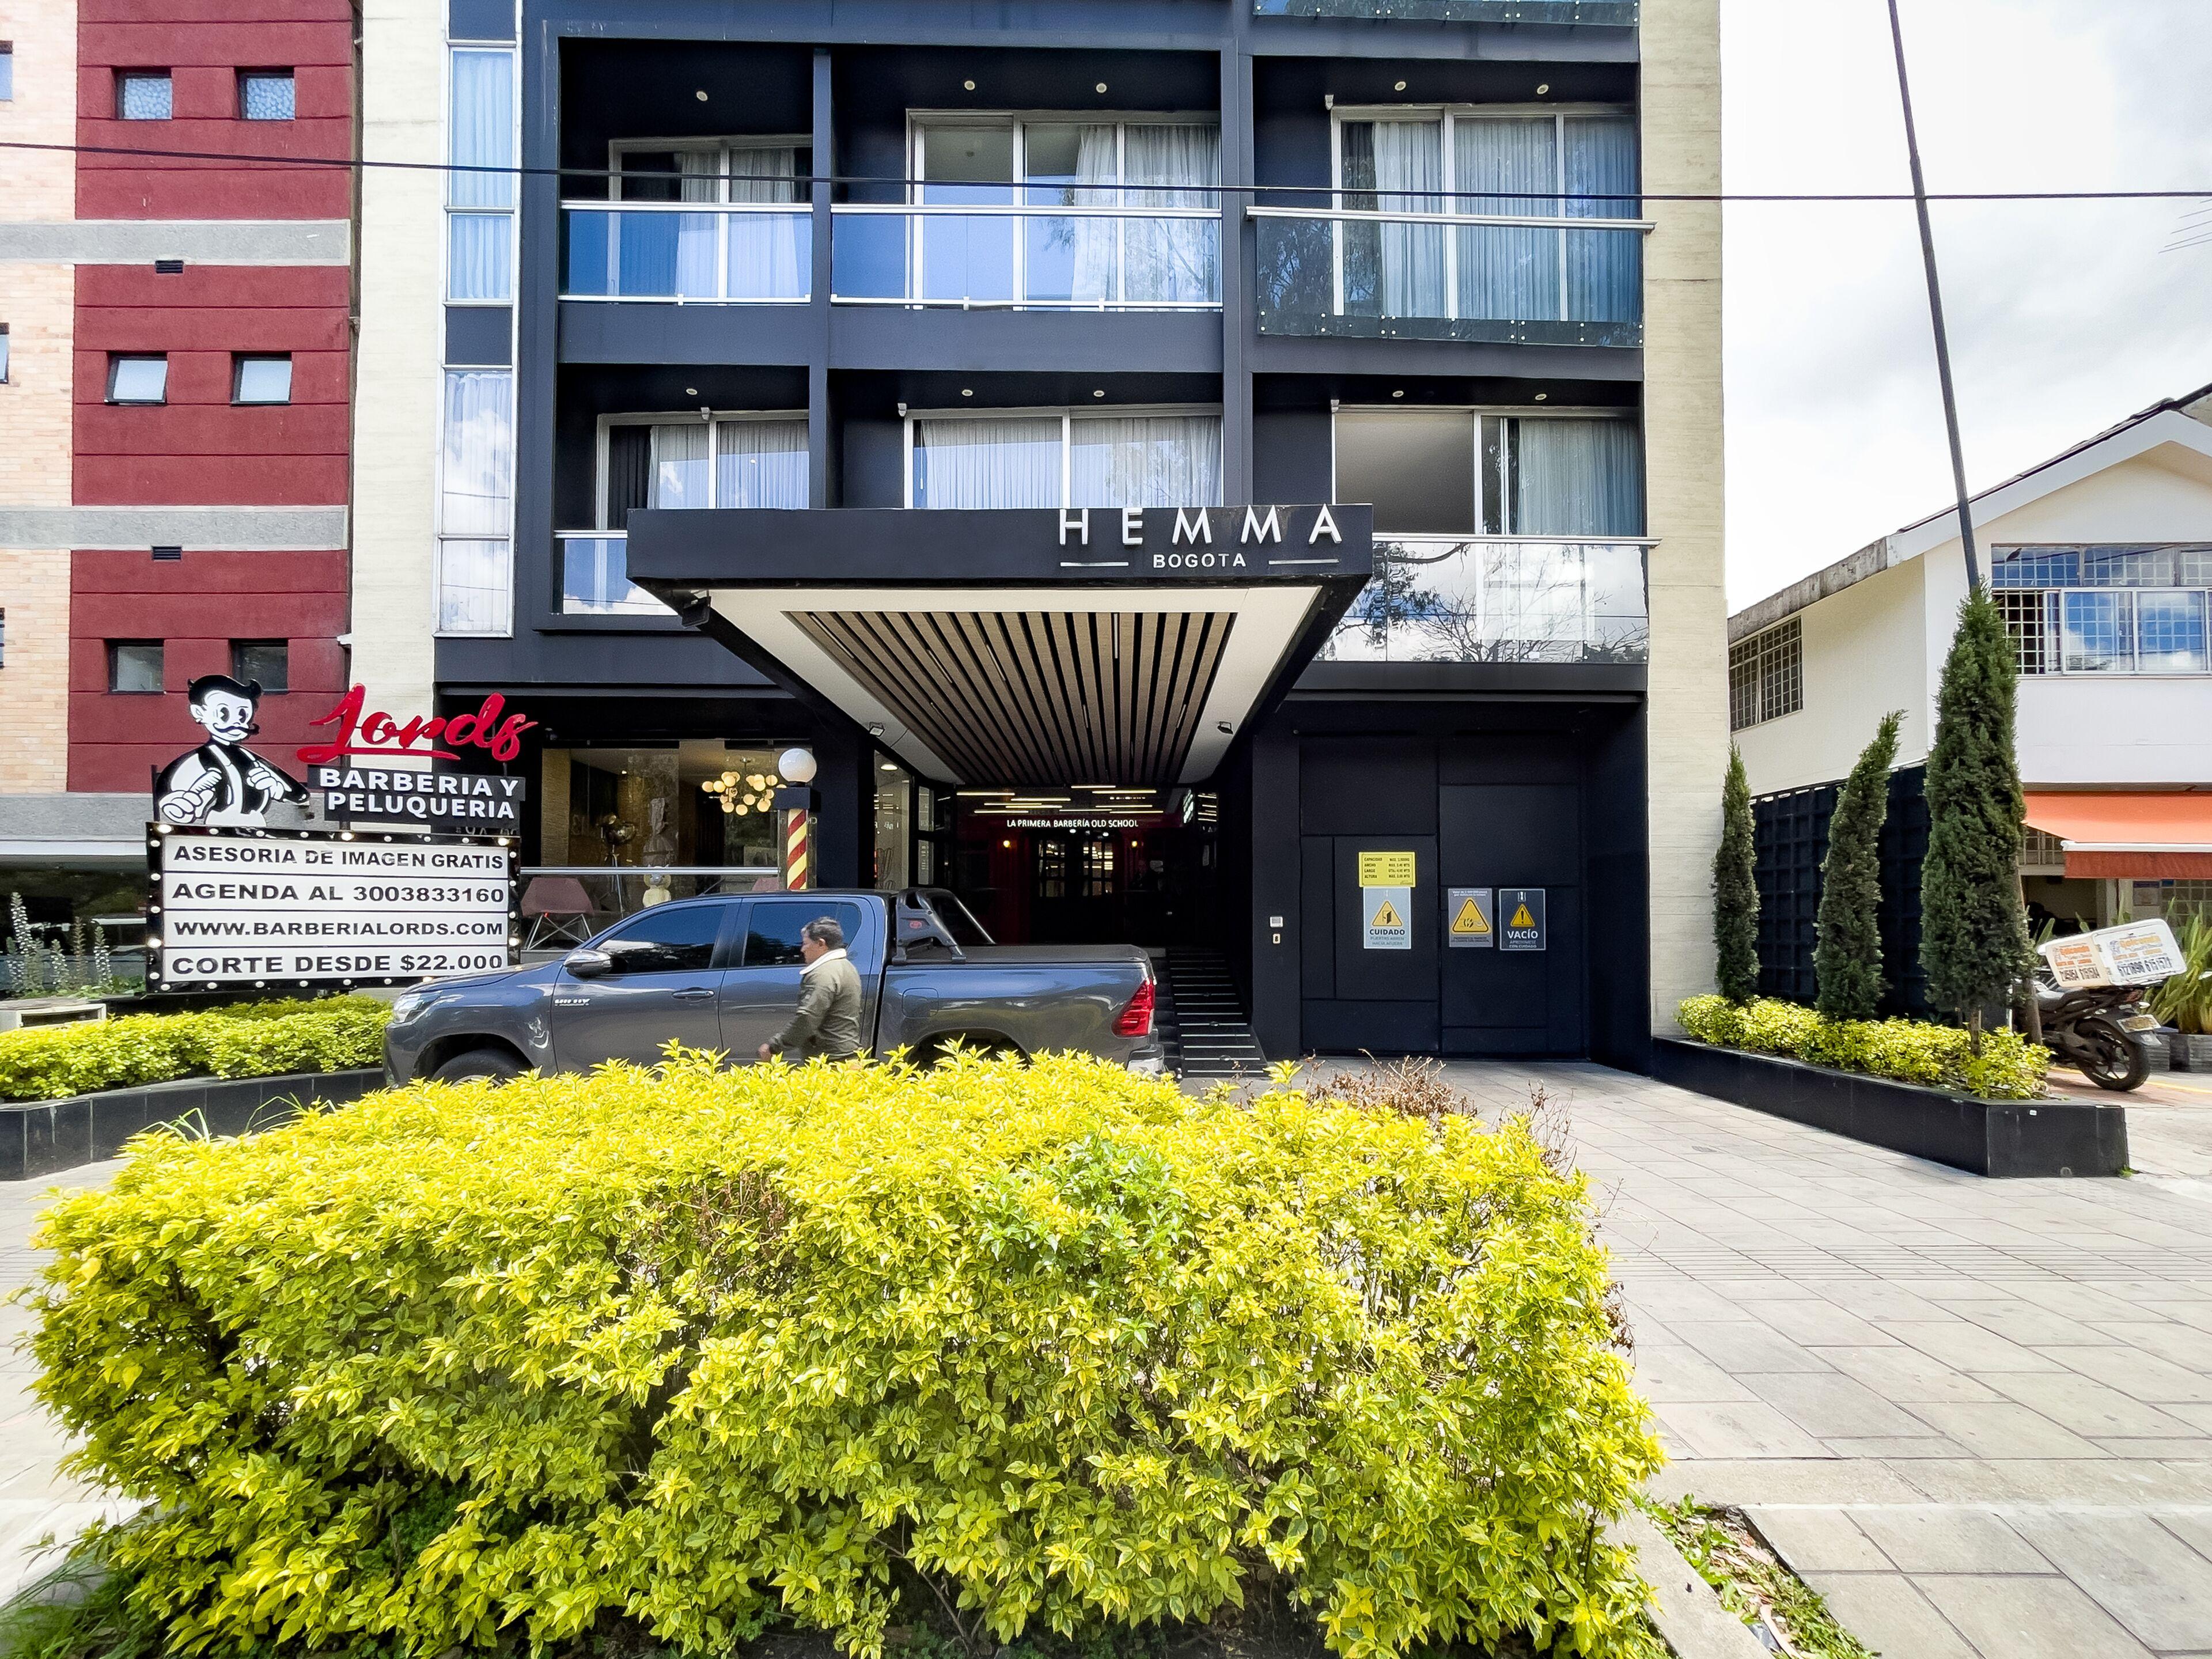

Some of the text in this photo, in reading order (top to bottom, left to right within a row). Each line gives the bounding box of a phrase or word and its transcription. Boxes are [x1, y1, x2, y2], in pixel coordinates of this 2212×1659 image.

[1059, 503, 1343, 546] HEMMA
[1153, 552, 1247, 569] BOGOTA
[319, 768, 518, 797] BARBERIA Y
[327, 793, 514, 819] PELUQUERIA
[1006, 818, 1138, 827] LA PRIMERA BARBERÍA OLD SCHOOL
[174, 846, 503, 869] ASESORIA DE IMAGEN GRATIS
[172, 883, 504, 903] AGENDA AL 3003833160
[174, 922, 502, 935] WWW.BARBERIALORDS.COM
[1507, 929, 1538, 938] VACÍO
[172, 955, 502, 974] CORTE DESDE $22.000
